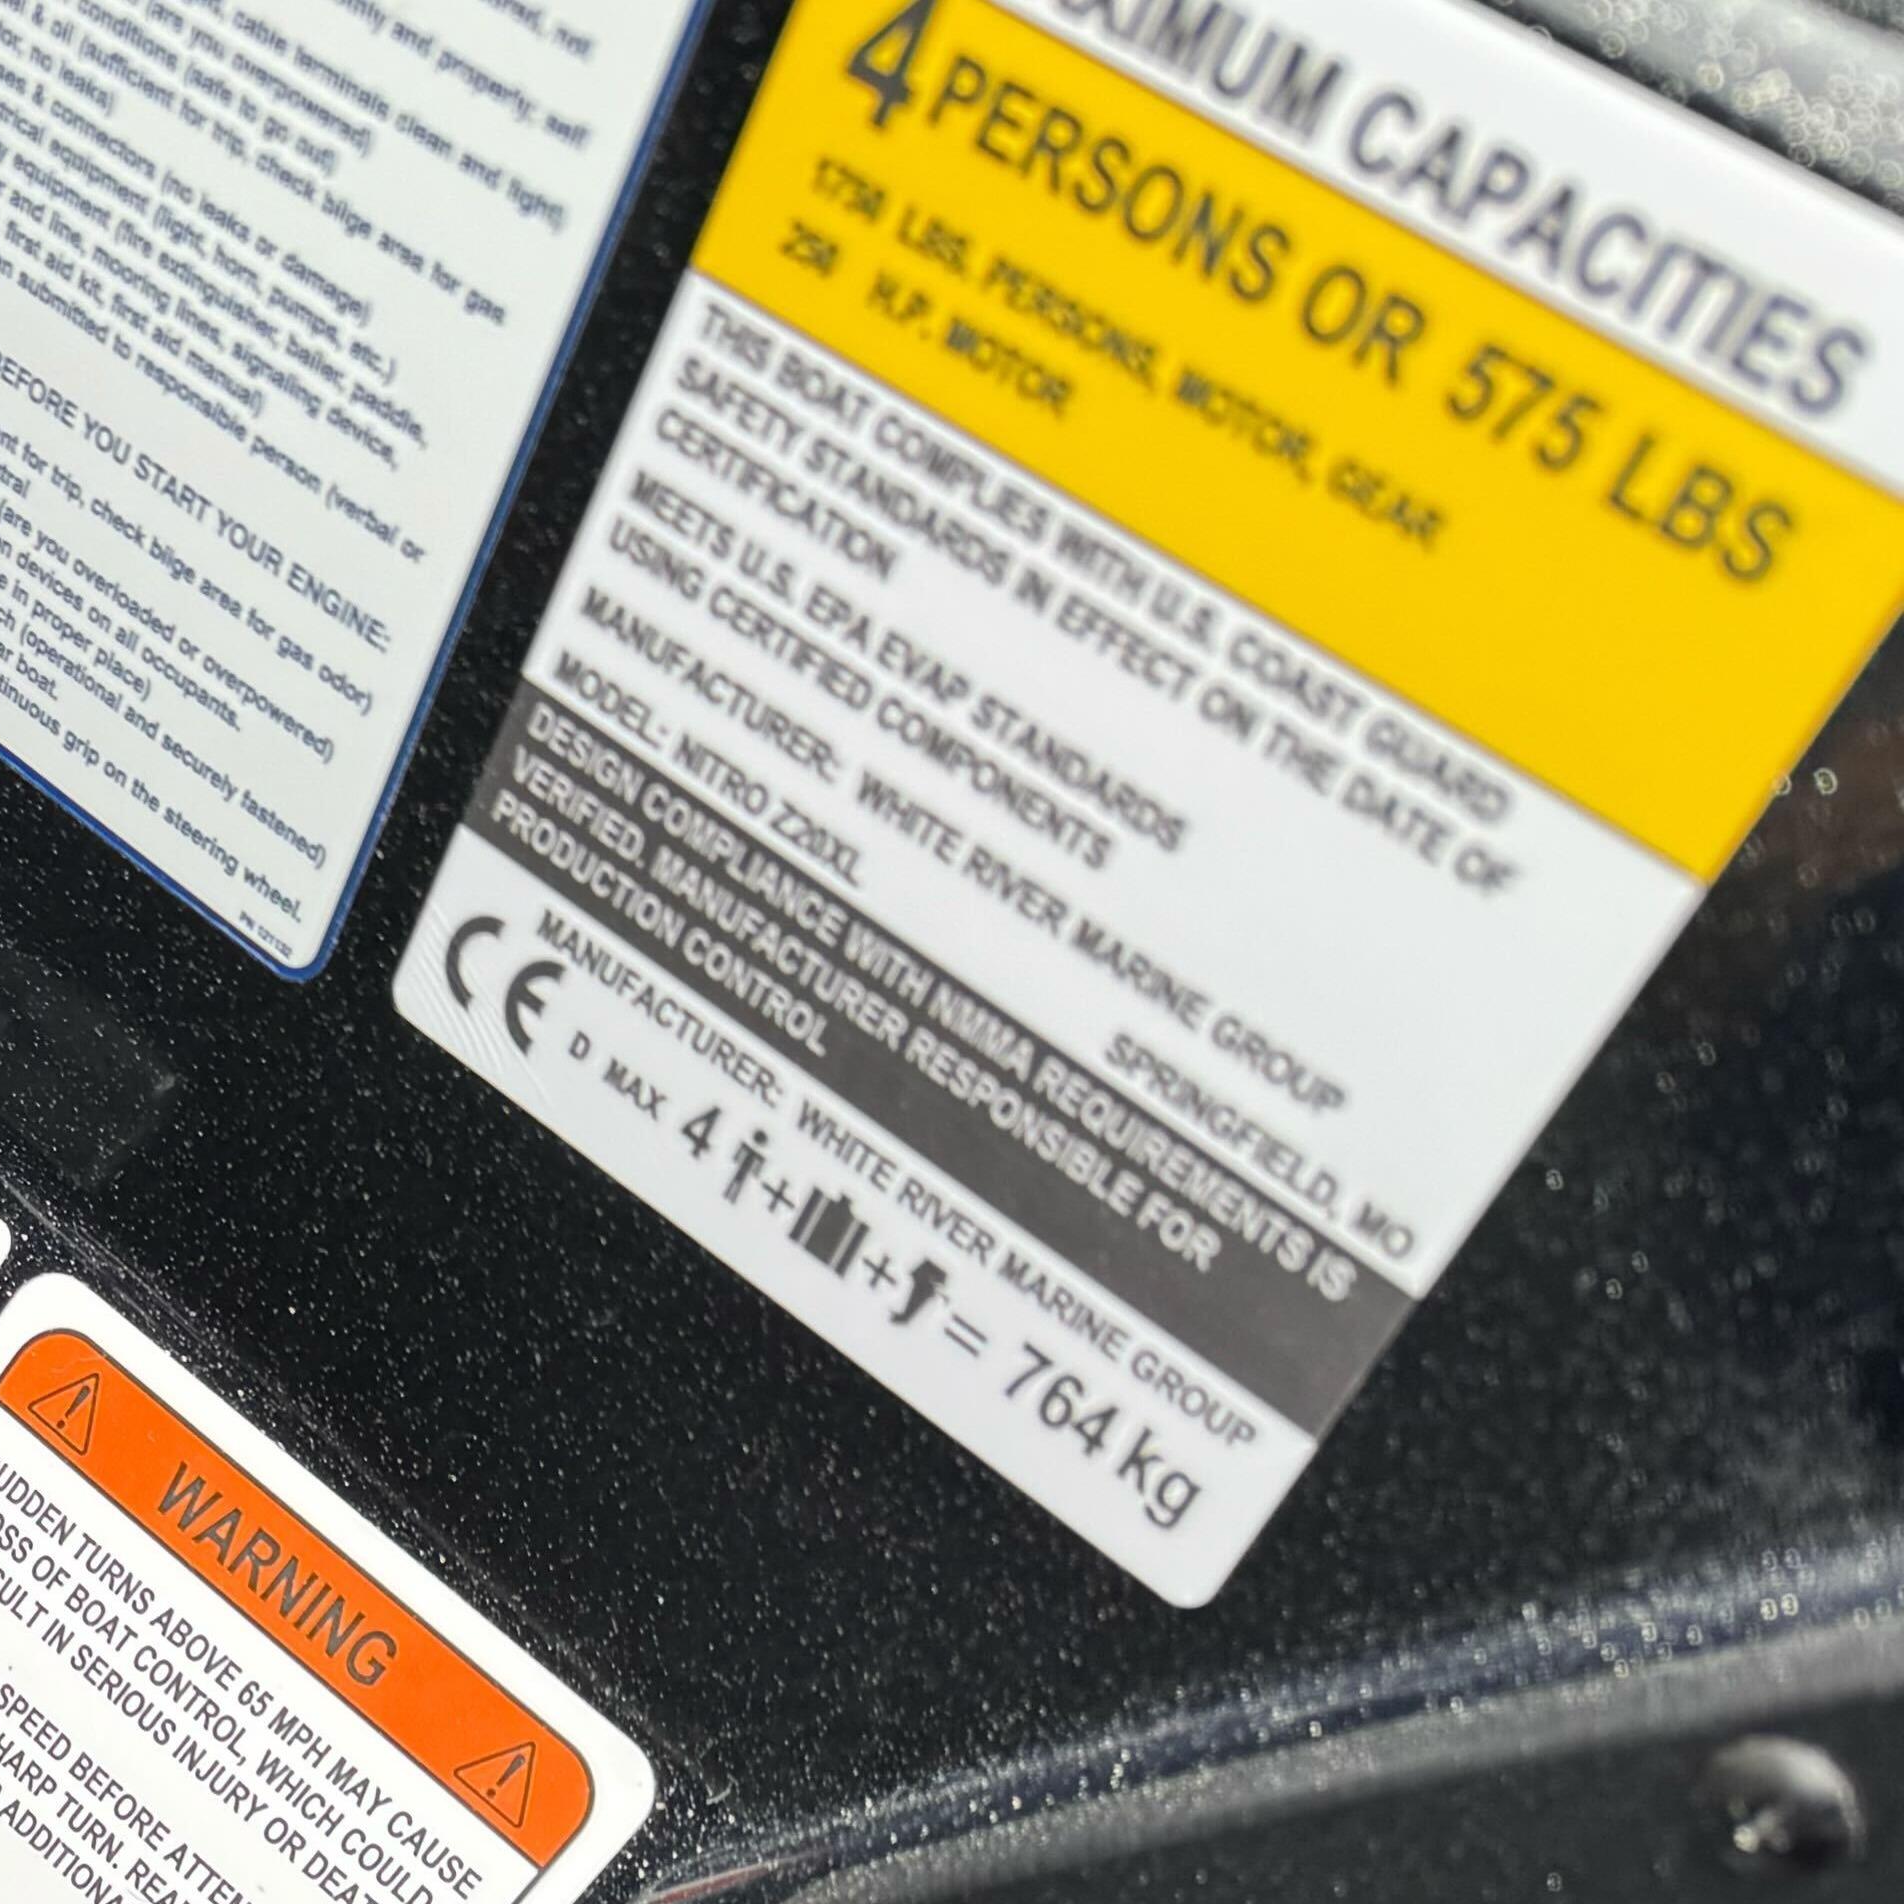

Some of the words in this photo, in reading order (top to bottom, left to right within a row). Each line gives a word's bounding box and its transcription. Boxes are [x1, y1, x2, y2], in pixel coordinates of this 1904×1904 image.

[844, 0, 941, 131] 4
[926, 51, 1294, 307] PERSONS
[1298, 261, 1430, 388] OR
[1444, 340, 1605, 474] 575
[1604, 432, 1796, 585] LBS
[1346, 89, 1870, 418] CAPACITIES
[82, 411, 133, 467] YOU
[132, 452, 214, 523] START
[216, 507, 285, 578] YOUR
[285, 561, 392, 655] ENGINE:
[655, 406, 898, 582] CERTIFICATION
[675, 354, 807, 454] SAFETY
[803, 435, 1012, 587] STANDARDS
[1013, 566, 1056, 614] IN
[1054, 592, 1199, 699] EFFECT
[1198, 684, 1261, 742] ON
[1265, 720, 1342, 796] THE
[1340, 773, 1453, 865] DATE
[1452, 845, 1517, 892] OF
[701, 301, 775, 374] THIS
[774, 349, 874, 430] BOAT
[873, 412, 1053, 544] COMPLIES
[1054, 522, 1149, 601] WITH
[1228, 631, 1366, 730] COAST
[1364, 717, 1511, 825] GUARD
[14, 651, 59, 702] boat.
[18, 621, 125, 714] (operational
[122, 704, 162, 742] and
[159, 732, 240, 804] securely
[238, 788, 328, 871] fastened)
[551, 648, 668, 751] MODEL:
[672, 732, 771, 818] NITRO
[608, 516, 707, 603] USING
[707, 584, 875, 712] CERTIFIED
[875, 695, 1114, 871] COMPONENTS
[627, 468, 737, 561] MEETS
[803, 583, 873, 654] EPA
[874, 629, 972, 706] EVAP
[970, 694, 1188, 854] STANDARDS
[61, 729, 101, 768] grip
[102, 760, 129, 789] on
[129, 777, 162, 814] the
[161, 805, 241, 878] steering
[242, 865, 302, 925] wheel.
[490, 788, 687, 949] PRODUCTION
[681, 926, 828, 1058] CONTROL
[578, 584, 840, 784] MANUFACTURER:
[856, 769, 964, 866] WHITE
[961, 843, 1070, 937] RIVER
[1070, 916, 1210, 1031] MARINE
[1210, 1014, 1347, 1111] GROUP
[512, 744, 646, 869] VERIFIED.
[649, 844, 910, 1052] MANUFACTURER
[904, 1025, 1146, 1218] RESPONSIBLE
[1135, 1190, 1223, 1274] FOR
[526, 701, 646, 806] DESIGN
[641, 782, 849, 948] COMPLIANCE
[843, 921, 935, 1008] WITH
[1032, 1055, 1316, 1273] REQUIREMENTS
[1305, 1247, 1358, 1303] IS
[534, 907, 784, 1110] MANUFACTURER:
[795, 1098, 899, 1191] WHITE
[895, 1176, 997, 1264] RIVER
[996, 1249, 1130, 1353] MARINE
[1129, 1349, 1258, 1444] GROUP
[1103, 1031, 1341, 1221] SPRINGFIELD,
[1350, 1200, 1417, 1261] MO
[601, 1056, 669, 1122] MAX
[679, 1104, 724, 1160] 4
[1003, 1340, 1121, 1459] 764
[1115, 1425, 1204, 1532] kg
[30, 1553, 73, 1592] OF
[63, 1582, 140, 1653] BOAT
[132, 1644, 248, 1768] CONTROL,
[254, 1747, 346, 1839] WHICH
[72, 1531, 157, 1616] TURNS
[148, 1606, 244, 1693] ABOVE
[236, 1679, 275, 1718] 65
[266, 1705, 333, 1770] MPH
[324, 1755, 394, 1818] MAY
[386, 1809, 484, 1902] CAUSE
[156, 1460, 398, 1687] WARNING
[40, 1617, 76, 1656] IN
[69, 1643, 178, 1747] SERIOUS
[170, 1733, 270, 1824] INJURY
[262, 1816, 308, 1865] OR
[55, 1789, 125, 1871] TURN.
[67, 1750, 172, 1853] BEFORE
